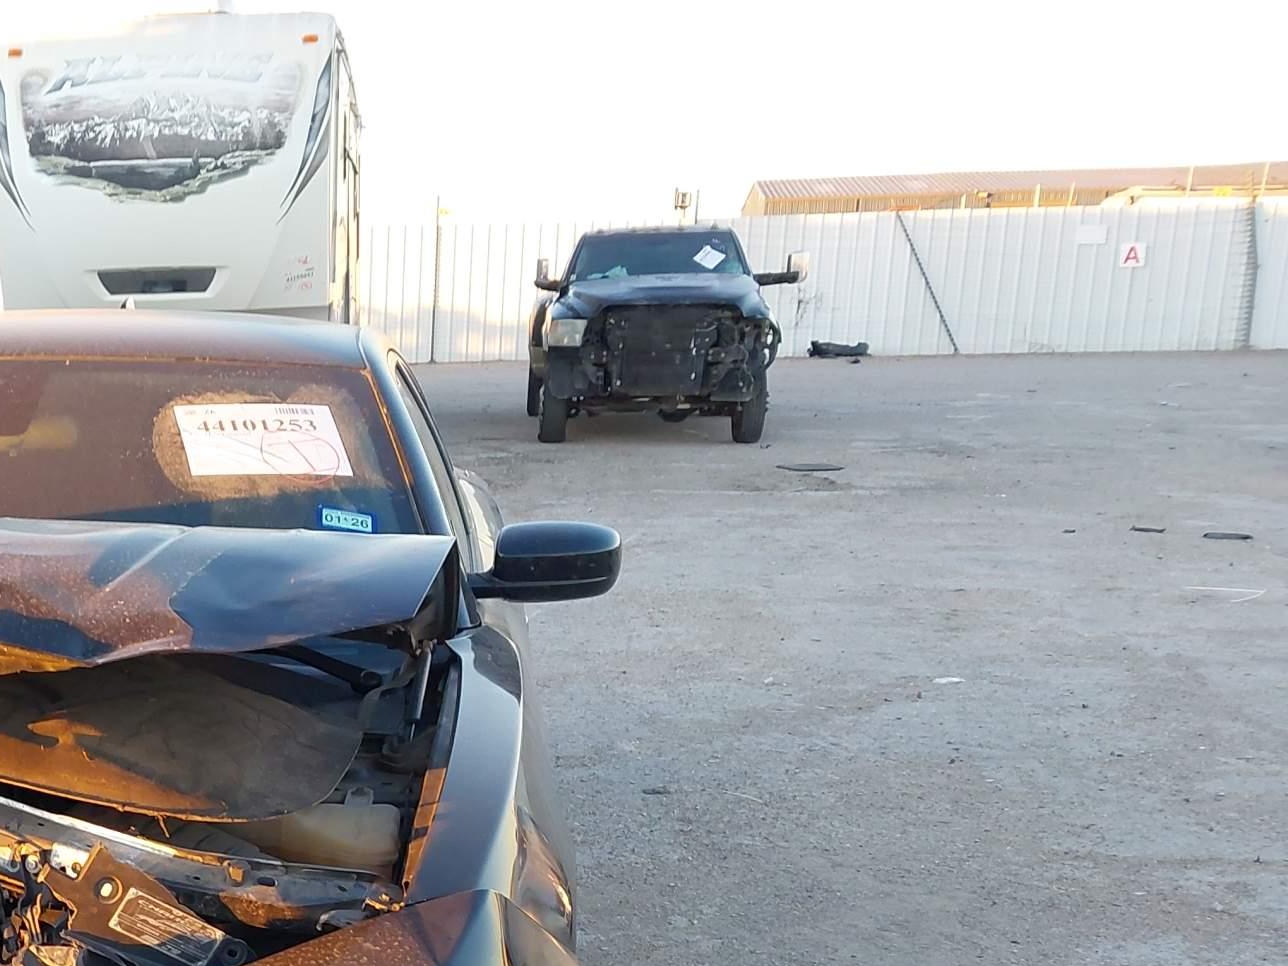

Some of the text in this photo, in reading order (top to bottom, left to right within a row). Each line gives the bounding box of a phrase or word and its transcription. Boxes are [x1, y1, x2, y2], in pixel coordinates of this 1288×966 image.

[1123, 246, 1140, 265] A
[197, 419, 317, 432] 44101253
[324, 513, 369, 529] 01 26
